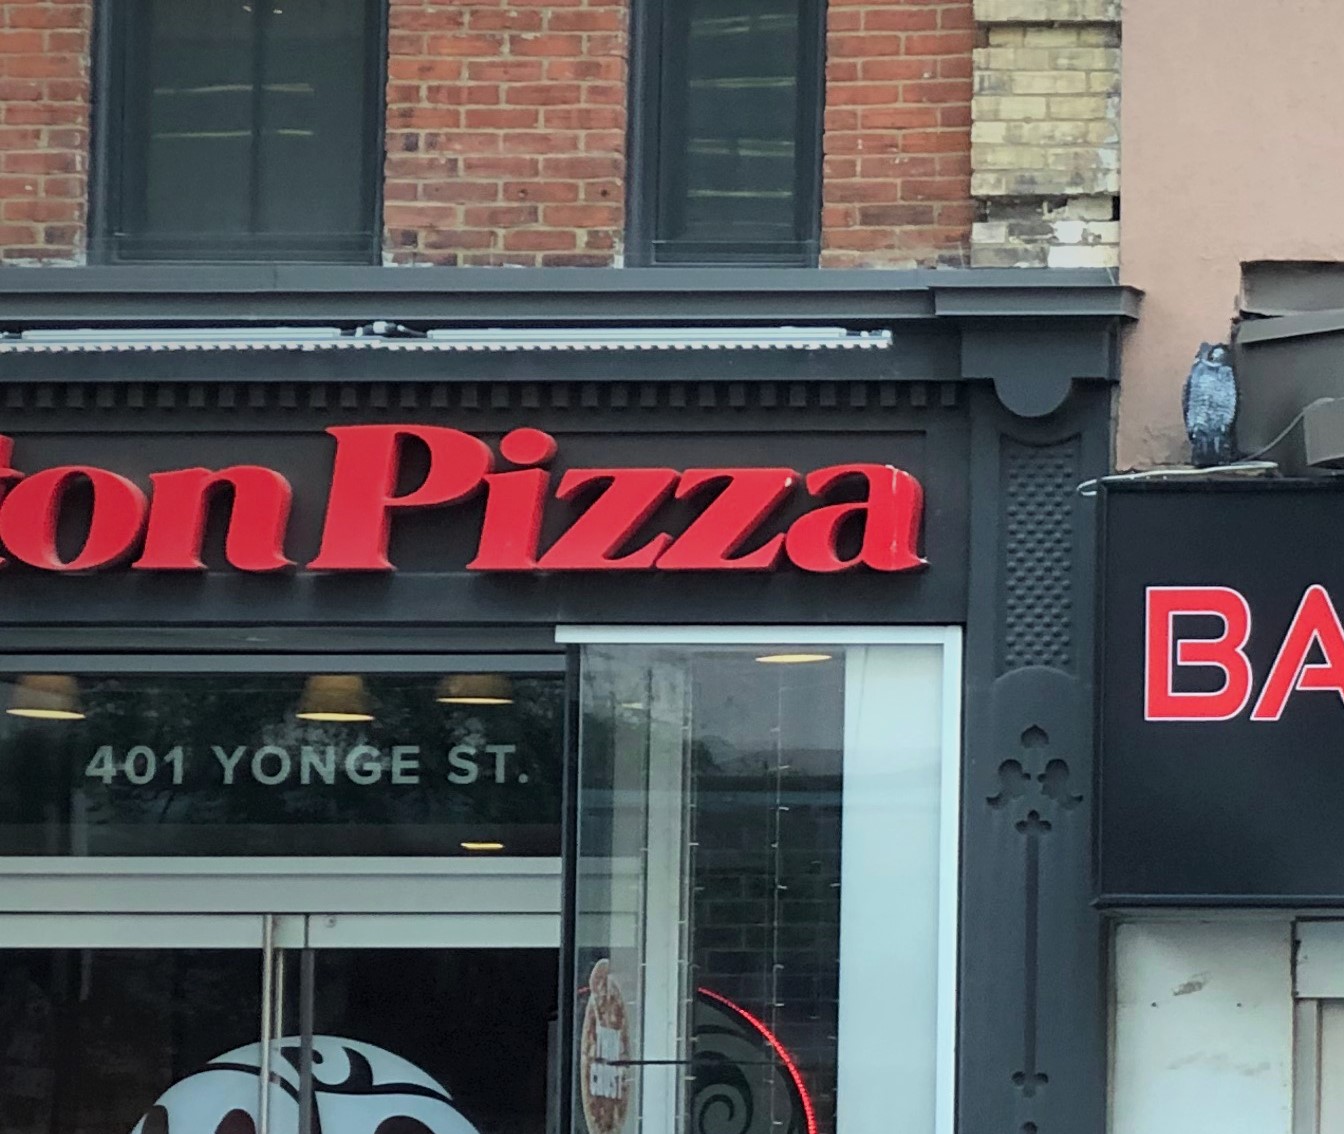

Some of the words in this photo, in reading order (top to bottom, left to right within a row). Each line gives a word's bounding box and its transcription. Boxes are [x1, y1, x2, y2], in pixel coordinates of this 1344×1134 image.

[0, 434, 296, 573] on
[306, 425, 930, 573] Pizza
[84, 744, 187, 786] 401
[213, 744, 422, 786] YONGE
[446, 743, 530, 786] ST.
